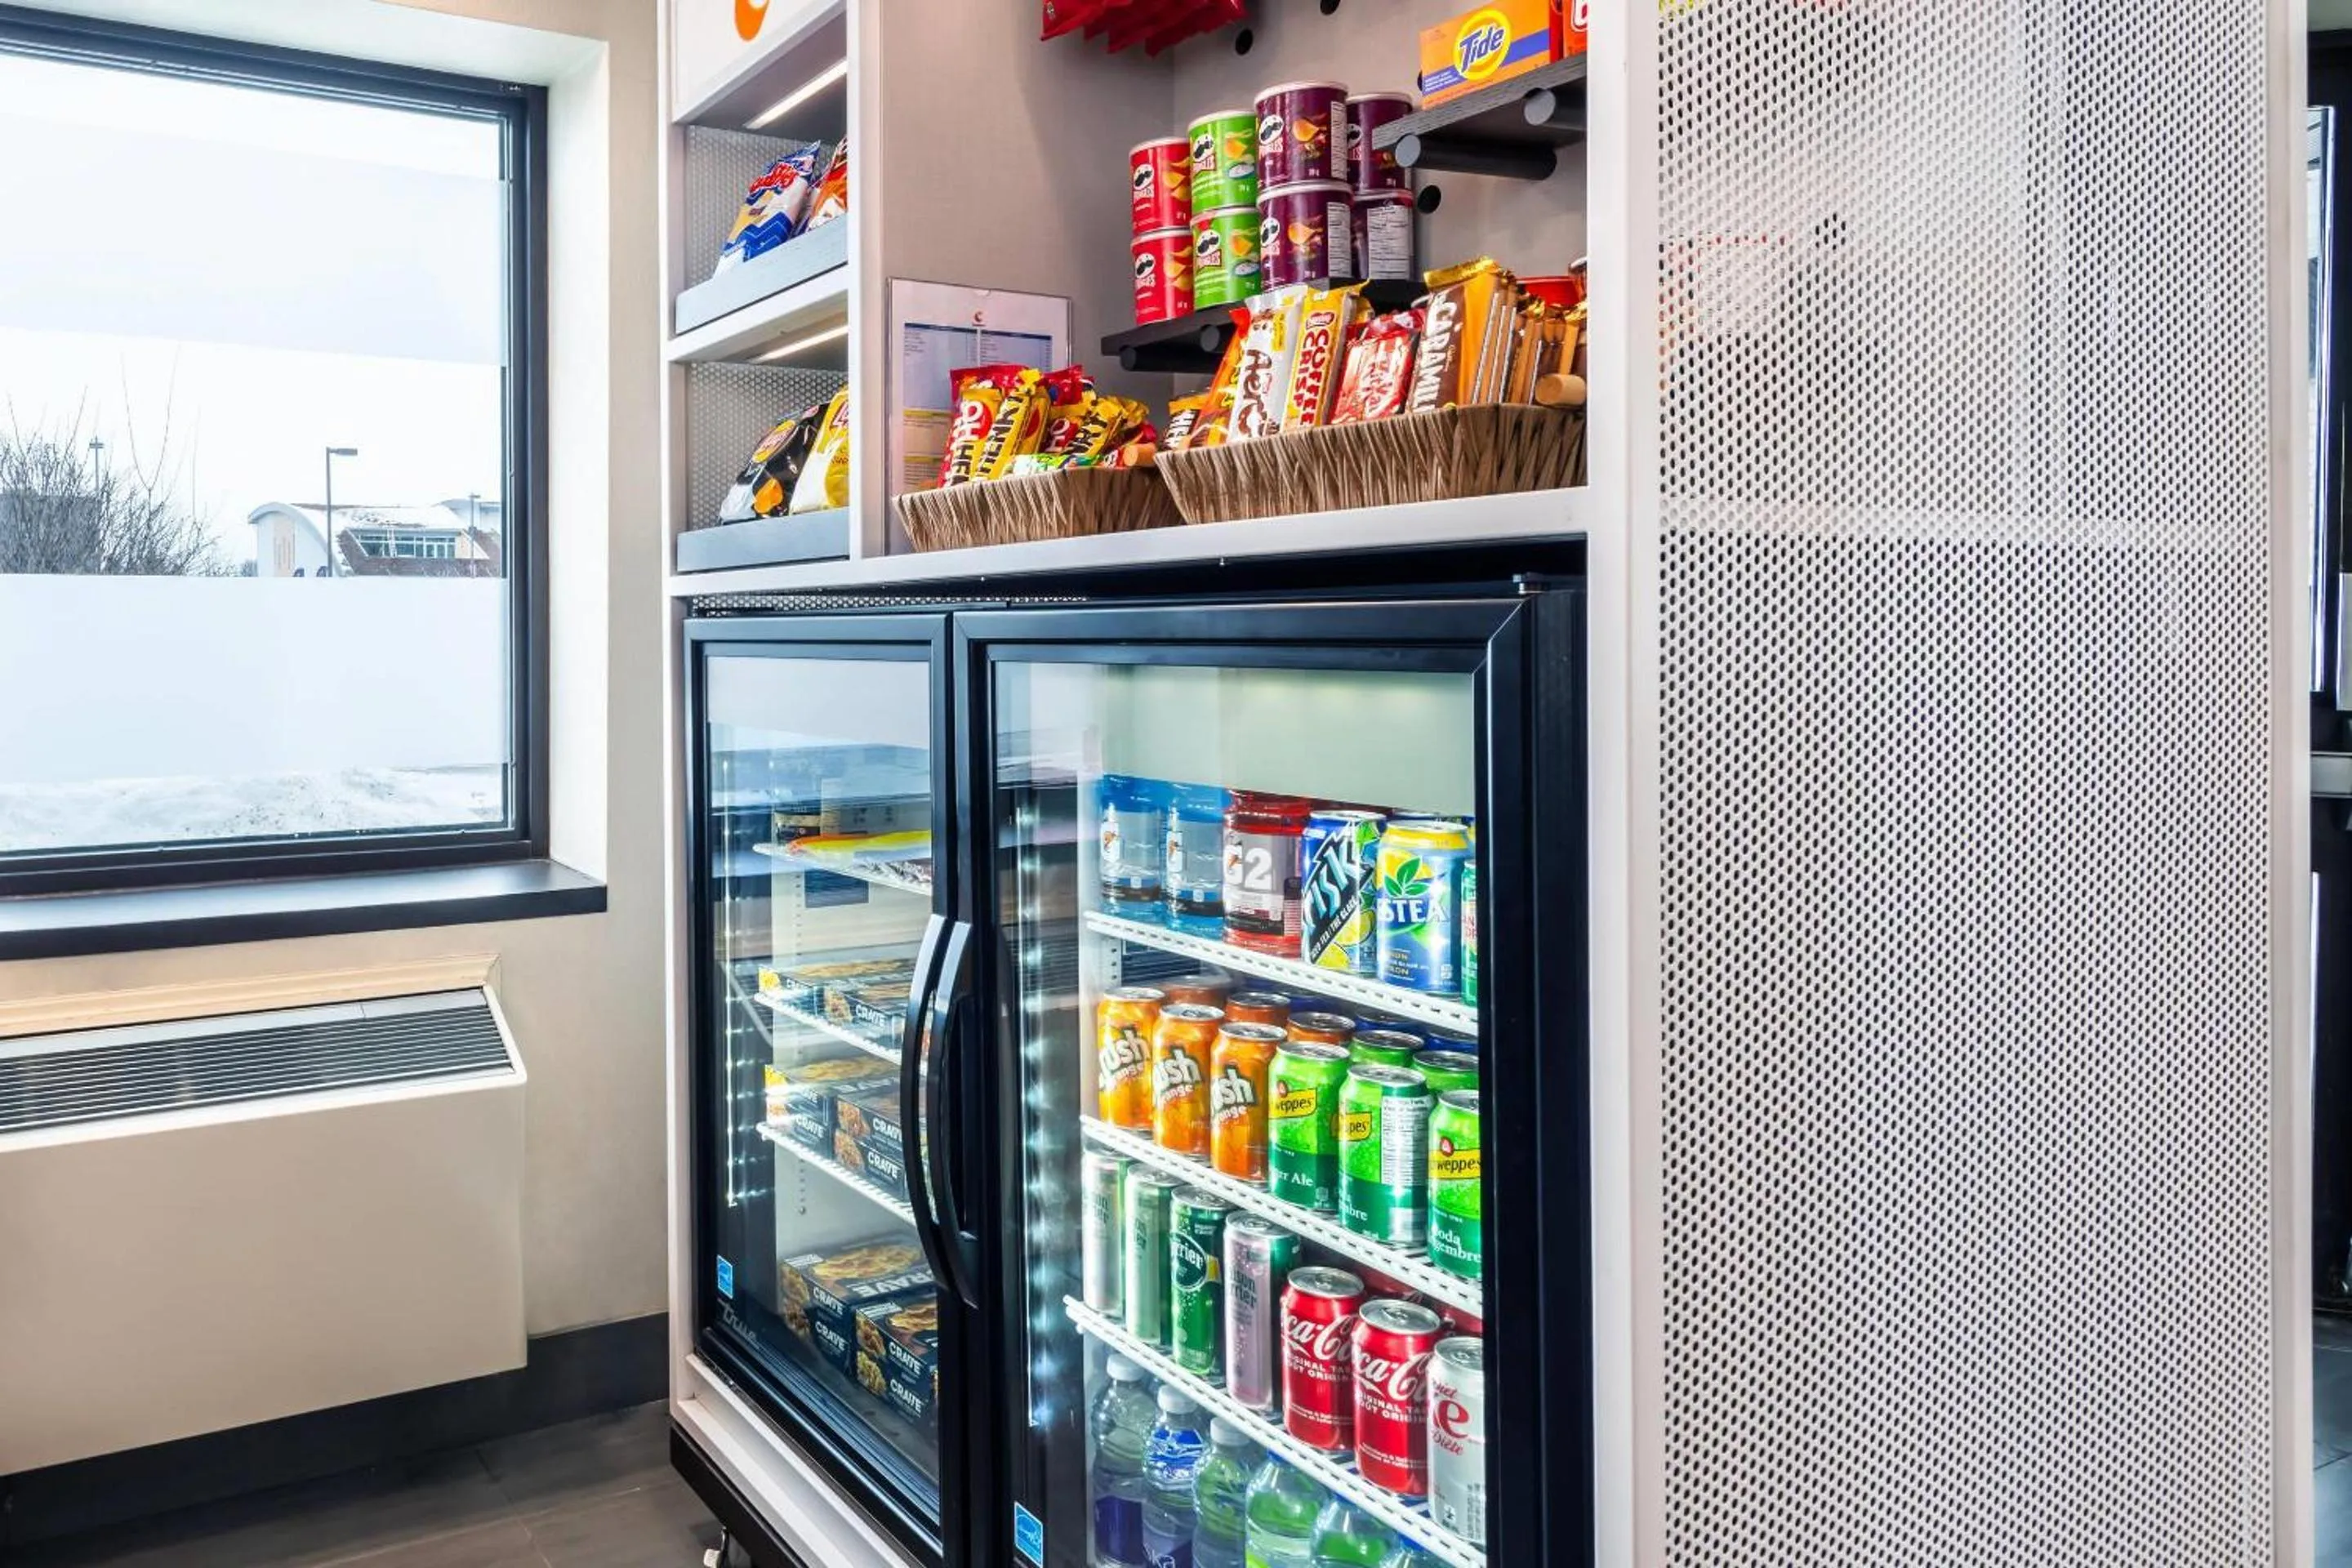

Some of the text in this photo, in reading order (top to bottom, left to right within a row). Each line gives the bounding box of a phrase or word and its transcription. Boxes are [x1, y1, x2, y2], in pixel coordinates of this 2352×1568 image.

[1459, 25, 1505, 73] Tide
[1293, 330, 1316, 408] CRISP
[1300, 328, 1330, 425] COFFEE
[867, 1152, 899, 1178] CRAVE
[1291, 1173, 1313, 1187] Ale
[813, 1286, 845, 1316] CRAVE
[815, 1321, 847, 1351] CRAVE
[889, 1341, 924, 1375] CRAVE
[889, 1378, 925, 1414] CRAVE
